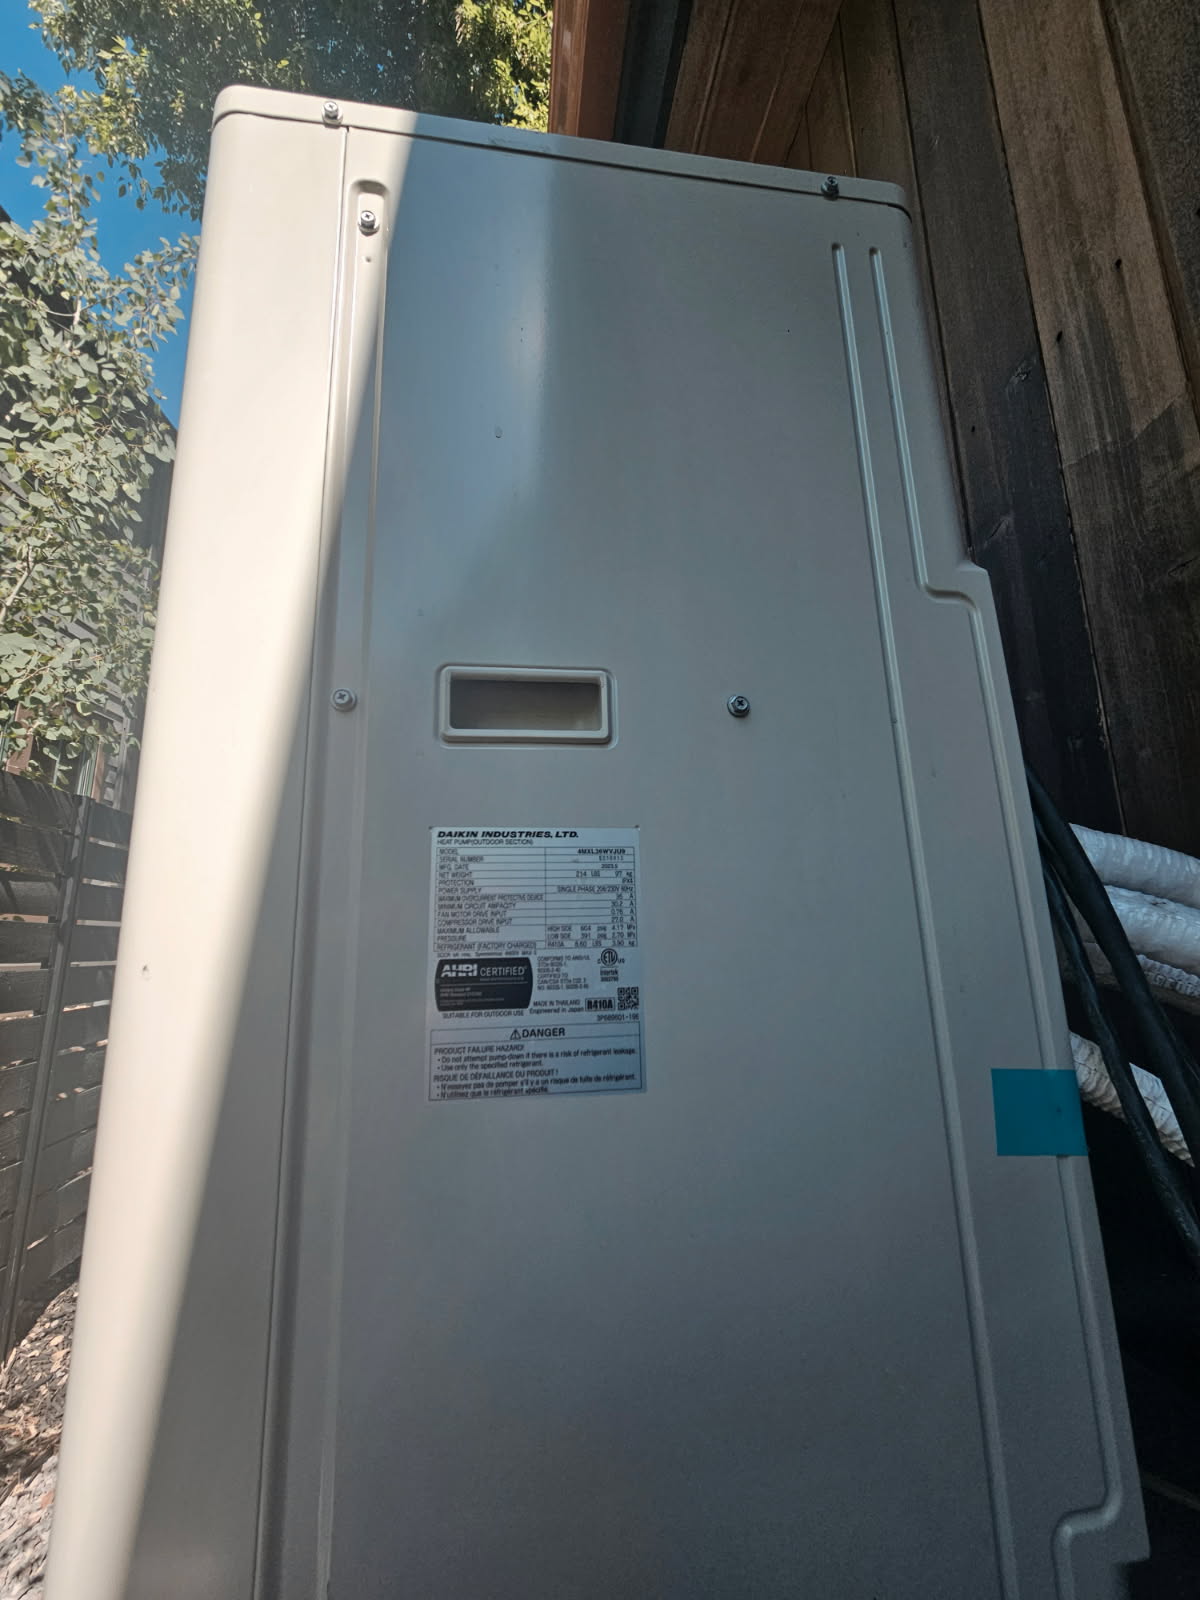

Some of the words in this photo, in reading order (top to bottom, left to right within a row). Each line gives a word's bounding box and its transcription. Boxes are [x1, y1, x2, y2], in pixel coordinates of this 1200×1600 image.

[481, 830, 552, 839] INDUSTRIES,
[555, 830, 579, 838] LTD.
[505, 838, 534, 846] SECTION)
[441, 964, 477, 977] AHRI
[480, 966, 525, 976] CERTIFIED
[587, 1000, 613, 1010] R410A
[522, 1028, 566, 1038] DANGER
[434, 1047, 466, 1055] PRODUCT
[468, 1045, 495, 1053] FAILURE
[464, 1055, 487, 1063] attempt
[489, 1053, 524, 1061] pump-down
[581, 1048, 611, 1057] refrigerant
[481, 1062, 508, 1070] specified
